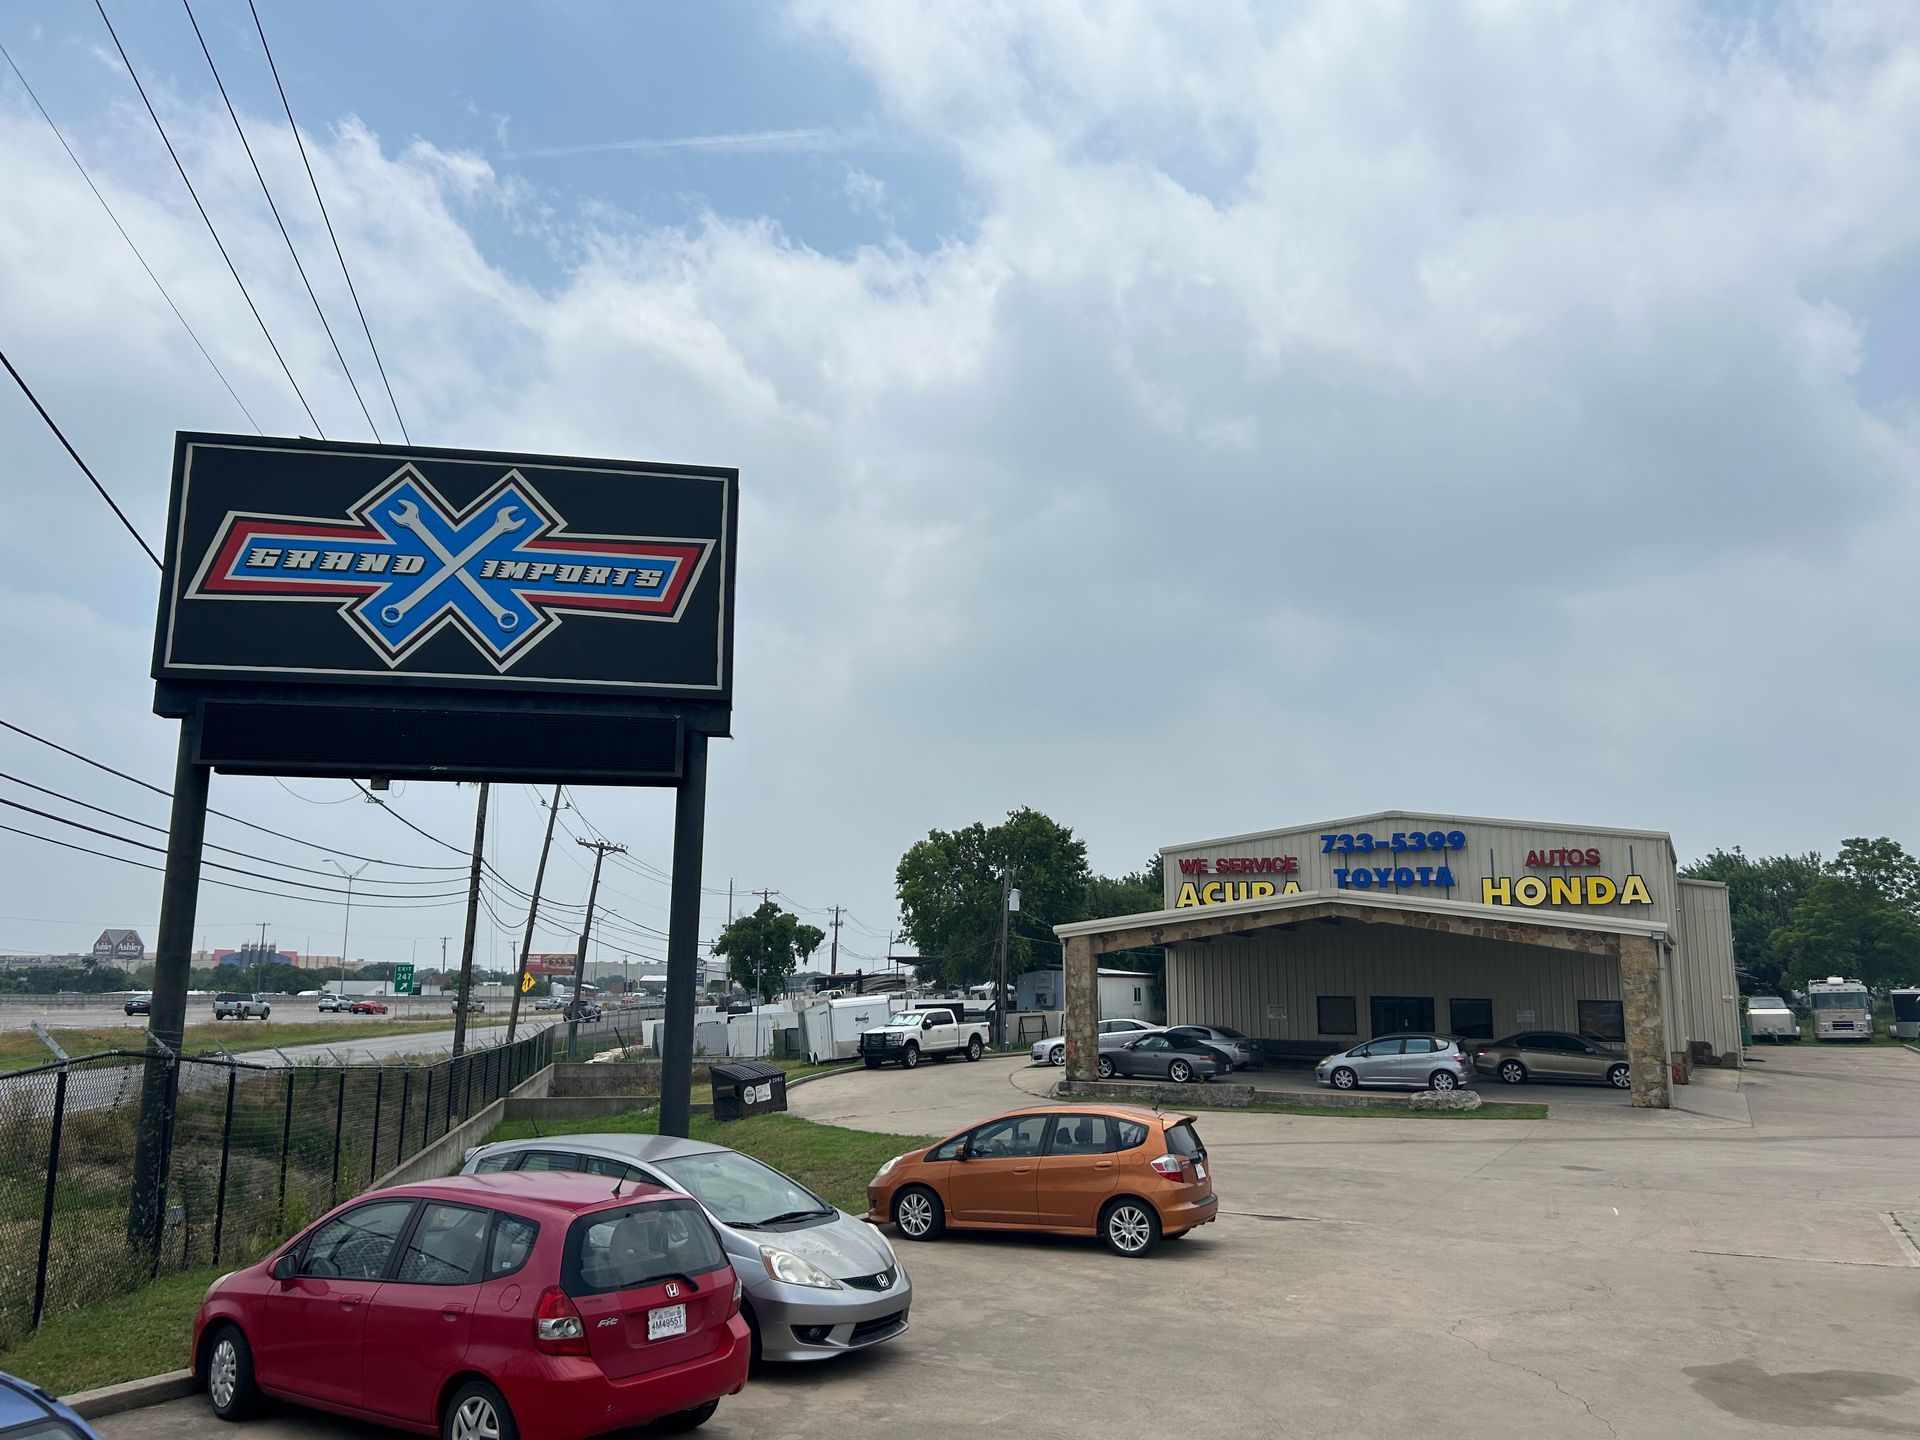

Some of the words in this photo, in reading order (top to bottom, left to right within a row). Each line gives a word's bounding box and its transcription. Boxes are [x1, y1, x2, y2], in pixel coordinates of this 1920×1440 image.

[245, 547, 426, 575] GRAND
[479, 559, 665, 588] IMPORTS
[1320, 830, 1467, 854] 733-5399
[1178, 858, 1209, 874] WE
[1215, 856, 1298, 874] SERVICE
[1525, 847, 1601, 867] AUTOS
[1333, 866, 1456, 889] TOYOTA
[1481, 874, 1654, 906] HONDA
[118, 942, 142, 952] Ashley
[597, 1317, 619, 1328] Fit
